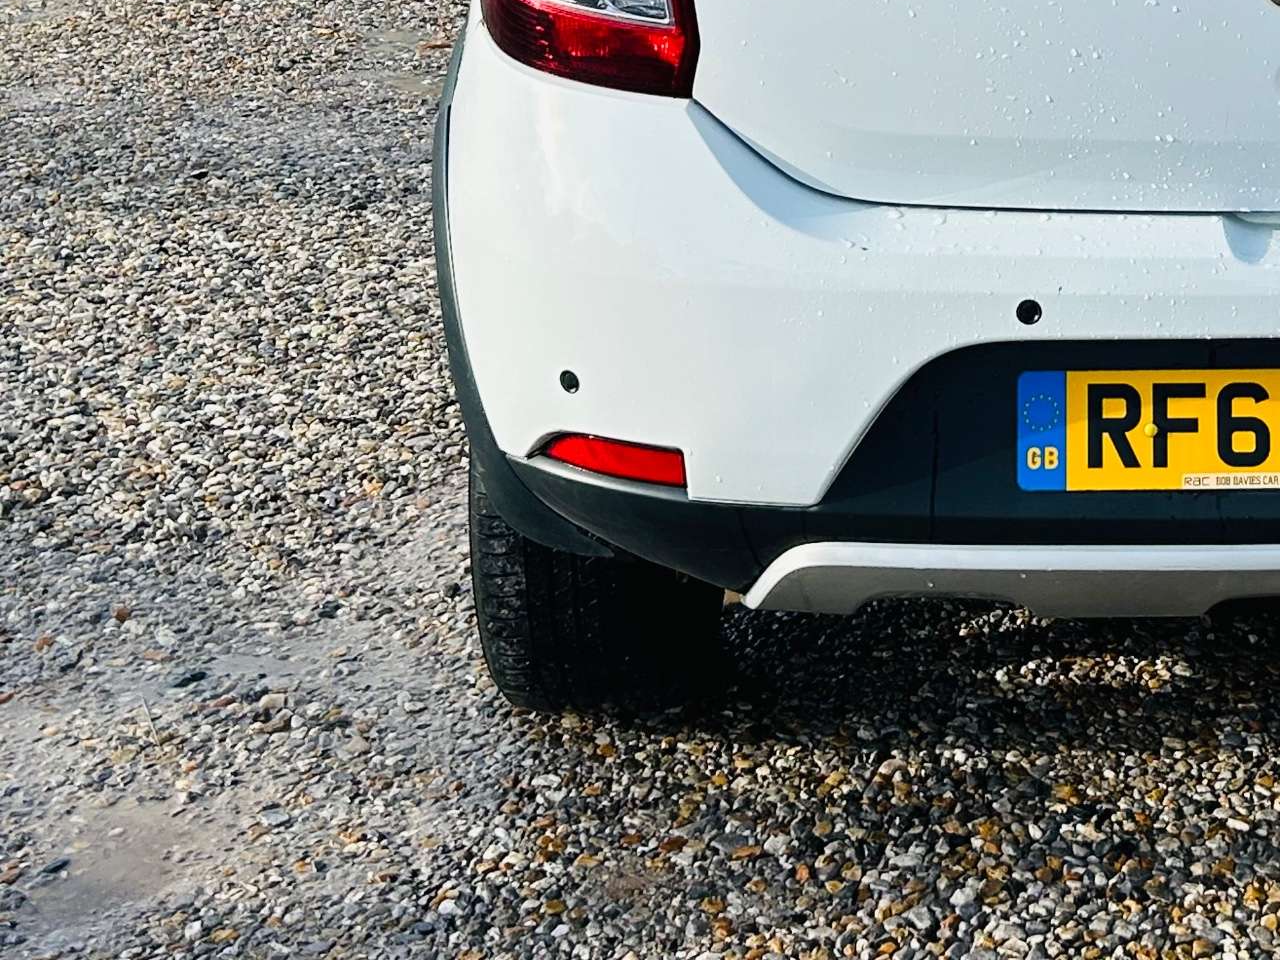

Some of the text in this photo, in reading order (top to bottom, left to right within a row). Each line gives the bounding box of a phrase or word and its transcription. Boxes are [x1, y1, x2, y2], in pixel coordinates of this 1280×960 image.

[1026, 446, 1059, 470] GB
[1216, 475, 1230, 486] BOB
[1233, 475, 1261, 486] DAVIES
[1262, 475, 1279, 485] CAR
